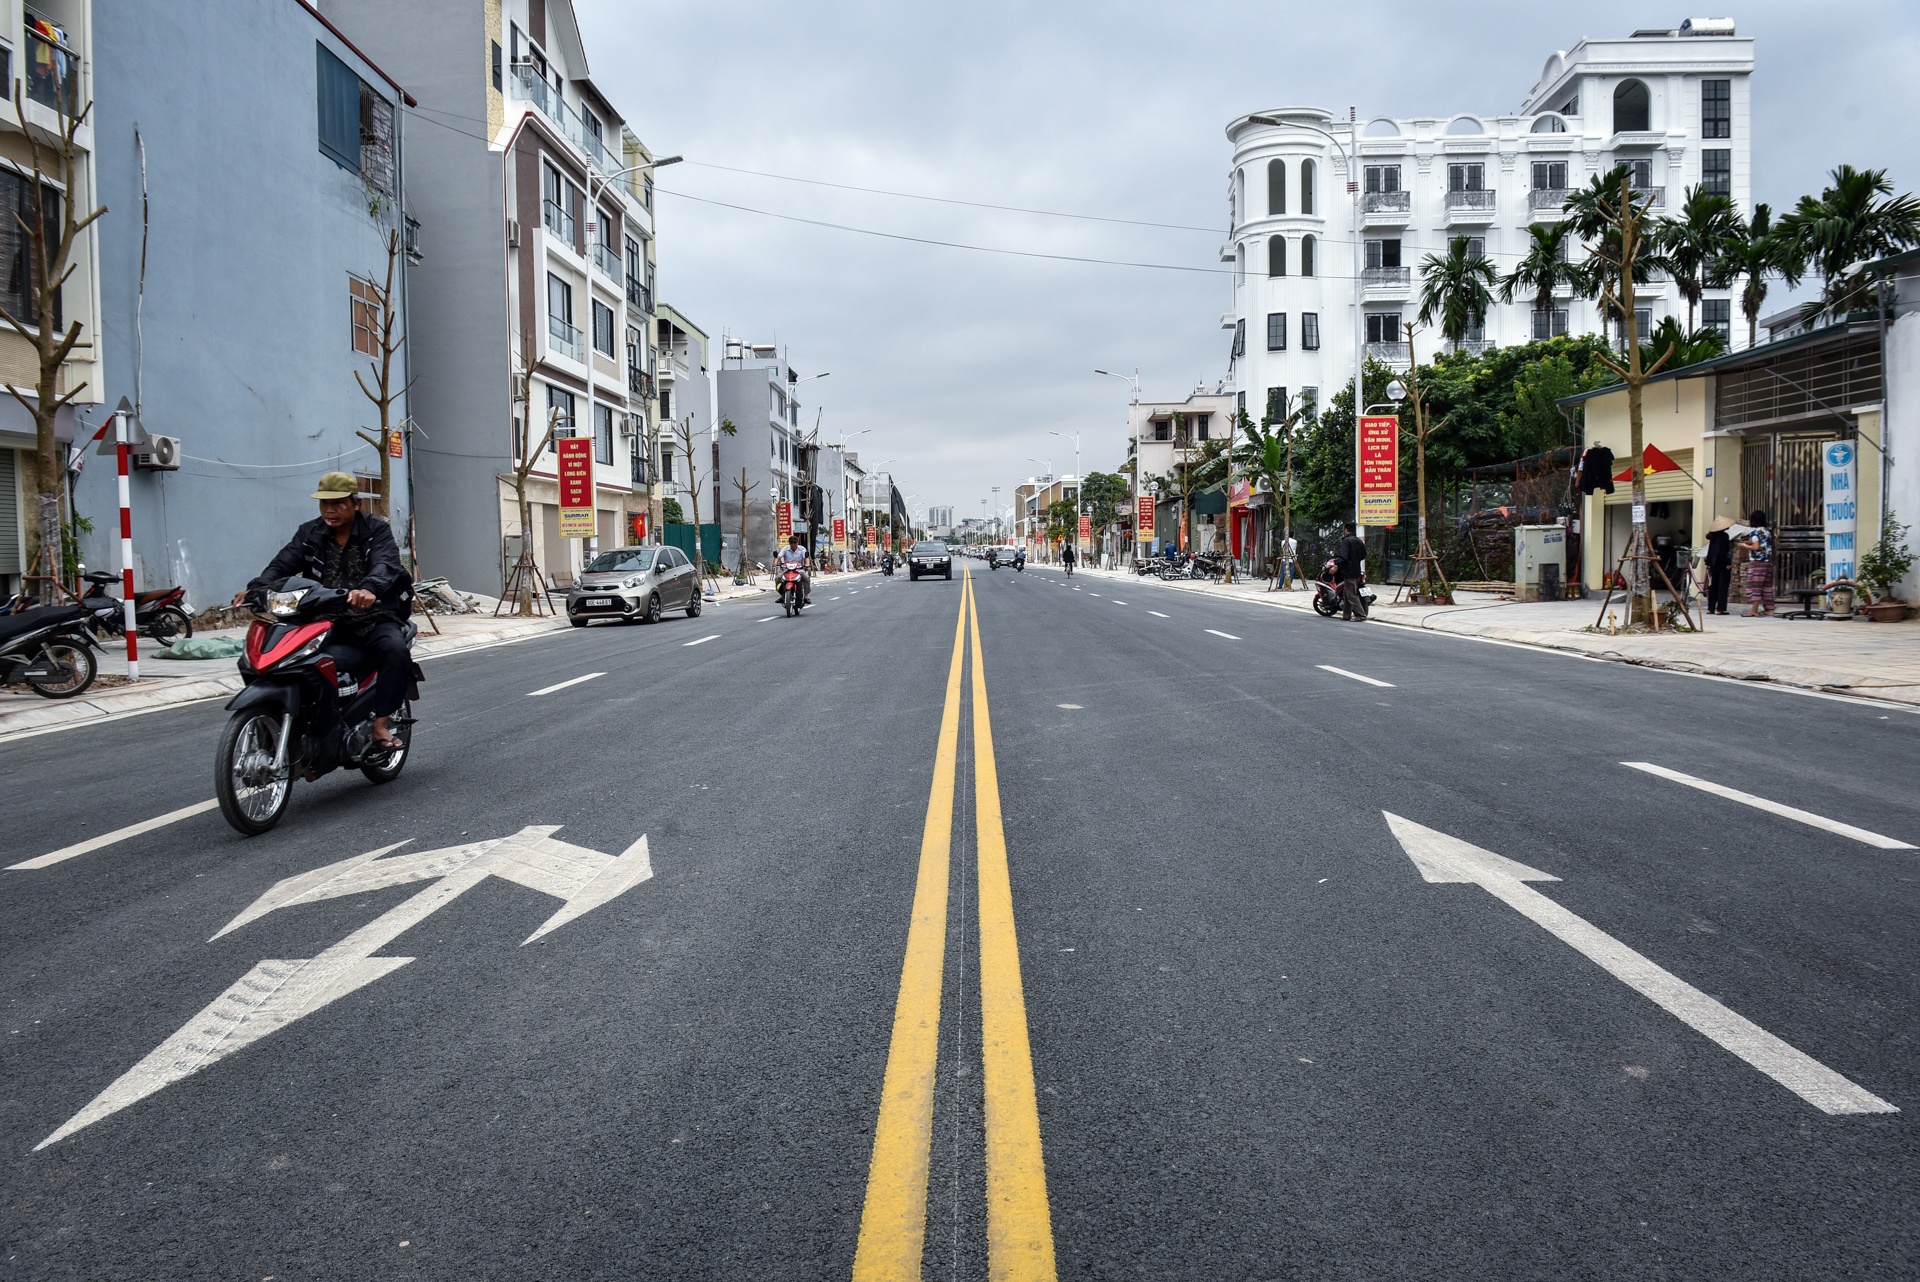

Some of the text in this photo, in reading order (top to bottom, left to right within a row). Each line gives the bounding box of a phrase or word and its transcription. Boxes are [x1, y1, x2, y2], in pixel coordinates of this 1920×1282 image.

[1831, 468, 1849, 490] NHÀ
[1826, 495, 1854, 521] THUỐC
[1830, 532, 1853, 550] MINH
